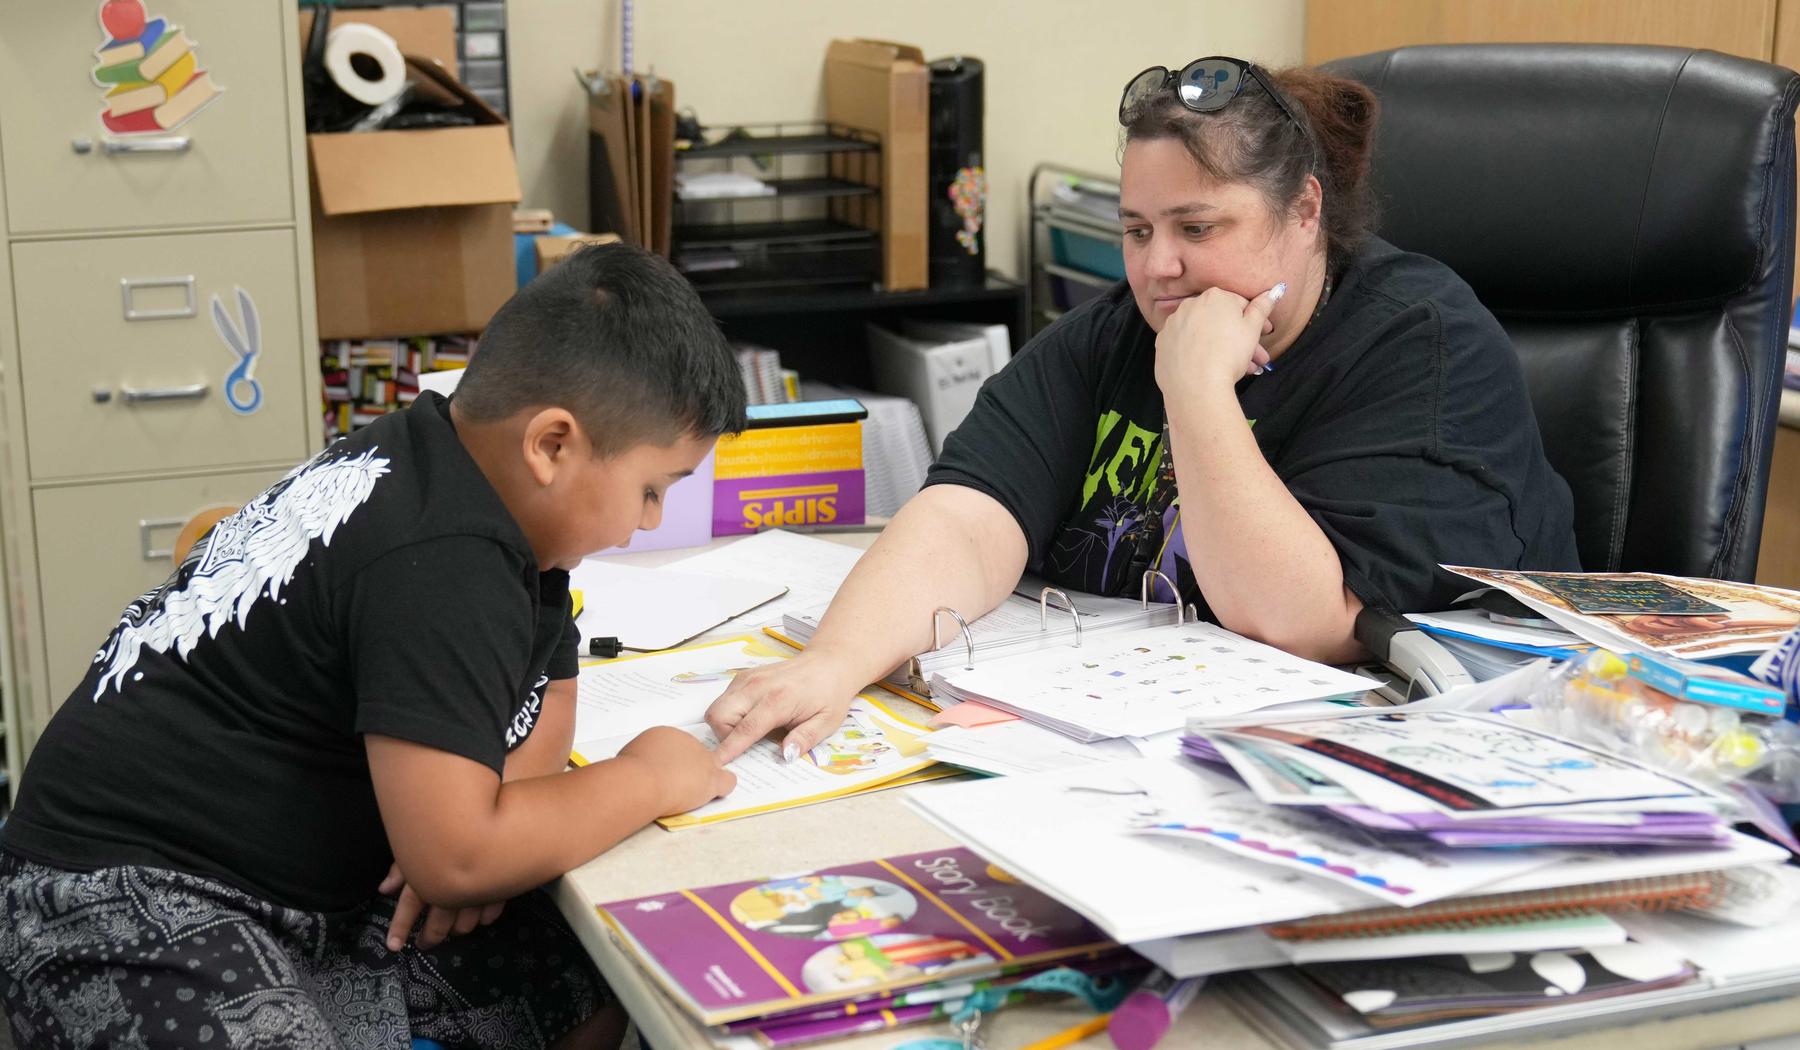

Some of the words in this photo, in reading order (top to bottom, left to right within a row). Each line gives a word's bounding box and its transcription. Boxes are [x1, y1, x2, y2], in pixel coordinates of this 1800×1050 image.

[742, 496, 838, 529] SIPPS
[914, 856, 987, 895] Story
[970, 896, 1052, 942] Book
